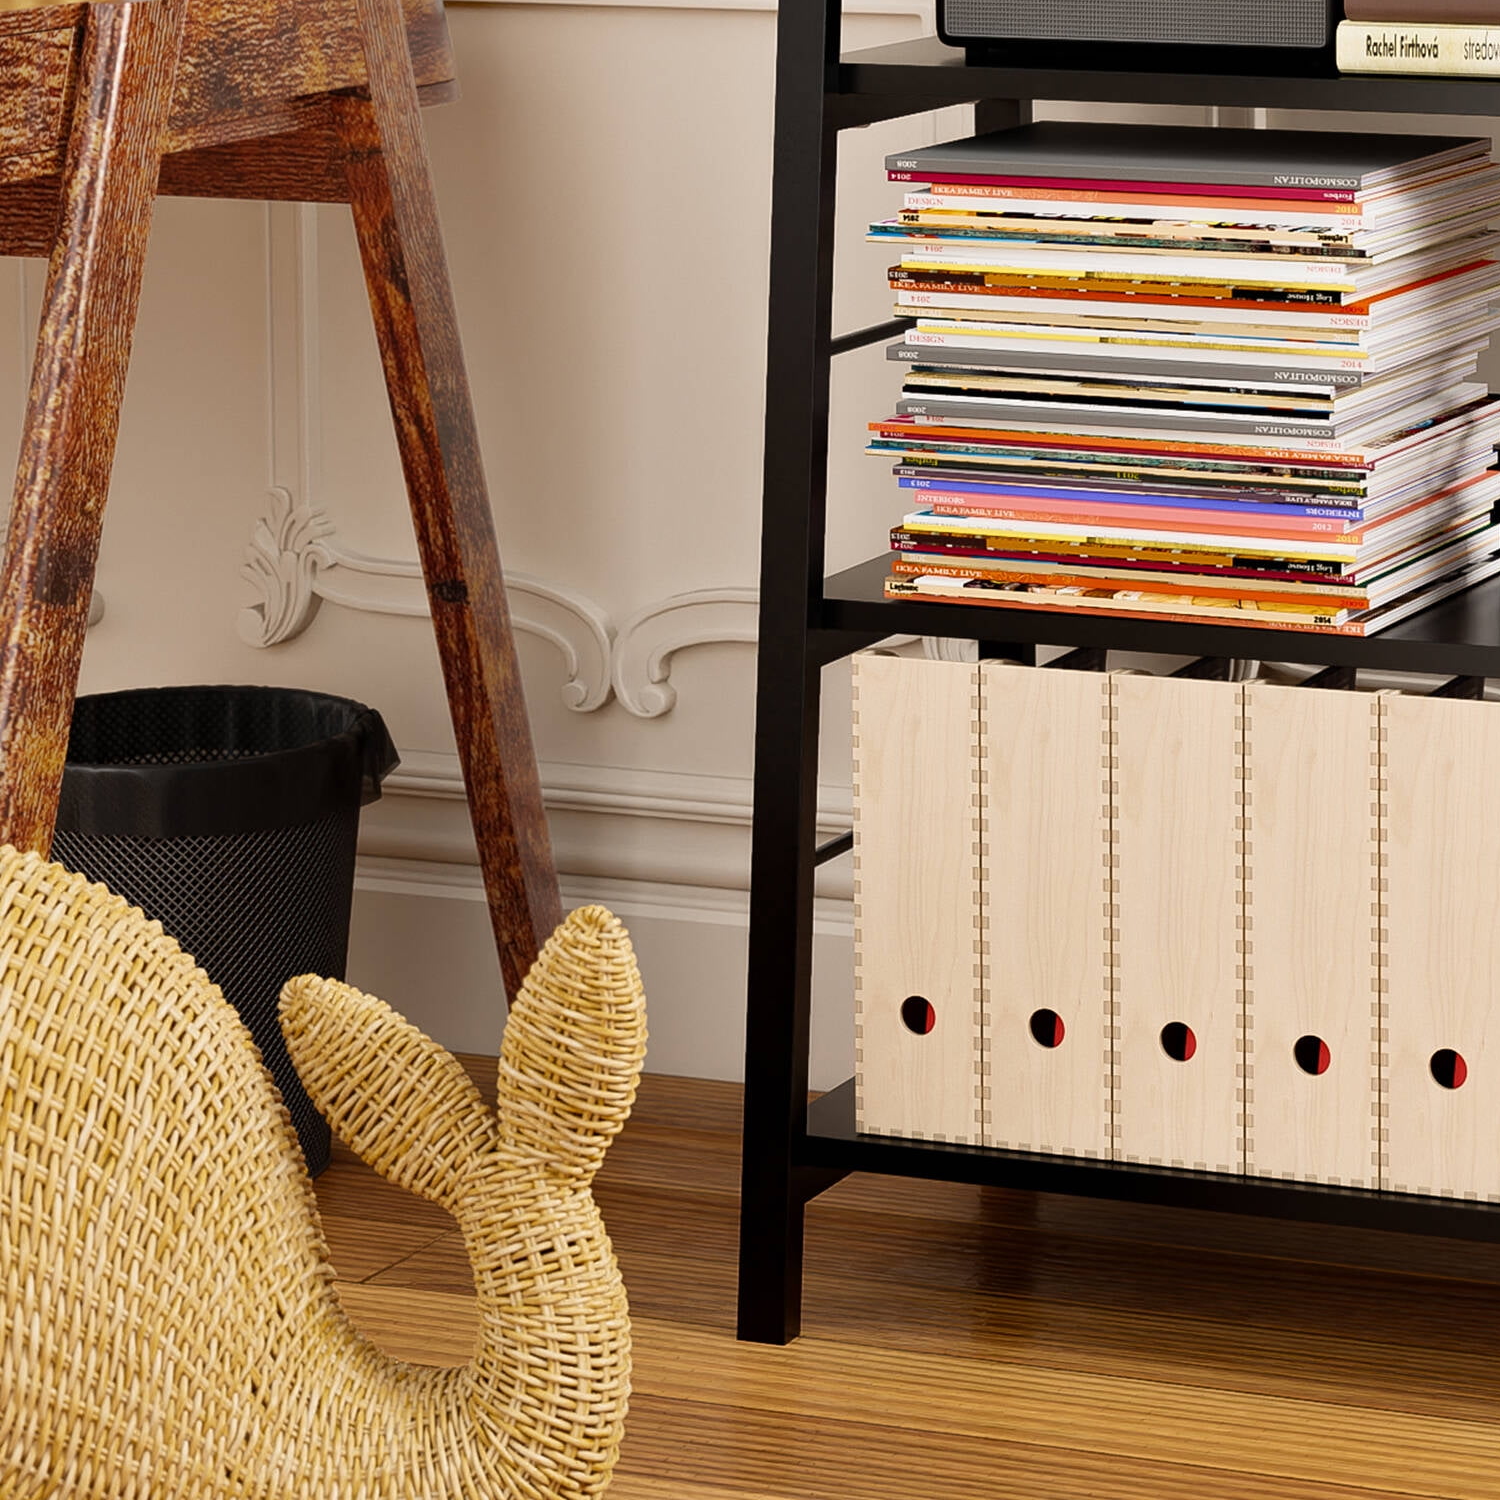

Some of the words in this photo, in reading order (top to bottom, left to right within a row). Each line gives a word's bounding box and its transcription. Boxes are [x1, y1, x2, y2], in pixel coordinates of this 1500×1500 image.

[1366, 33, 1397, 57] Rachel
[1400, 34, 1439, 58] Firthová
[896, 160, 918, 169] 2008
[891, 172, 911, 181] 2014
[1273, 175, 1358, 187] COSMOPOLITAN
[934, 187, 957, 195] IKEA
[958, 187, 991, 197] FAMILY
[992, 188, 1013, 197] LIVE
[1334, 205, 1358, 214] 2010
[1323, 192, 1354, 200] Forbes
[908, 197, 943, 206] DESIGN
[893, 281, 919, 290] IKEA
[919, 282, 956, 291] FAMILY
[958, 284, 981, 292] LIVE
[911, 295, 931, 303] 2014
[1316, 294, 1333, 303] Log
[1330, 317, 1369, 327] DESIGN
[898, 351, 919, 359] 2008
[909, 334, 945, 344] DESIGN
[1341, 360, 1362, 369] 2014
[1274, 371, 1358, 384] COSMOPOLITAN
[1255, 425, 1332, 437] COSMOPOLITAN
[917, 494, 966, 504] INTERIORS
[1306, 507, 1360, 518] INTERIORS
[936, 505, 959, 514] IKEA
[960, 506, 993, 516] FAMILY
[994, 508, 1015, 517] LIVE
[1336, 535, 1359, 544] 2010
[896, 565, 920, 573] IKEA
[921, 566, 958, 576] FAMILY
[960, 570, 983, 578] LIVE
[1317, 564, 1333, 573] Log
